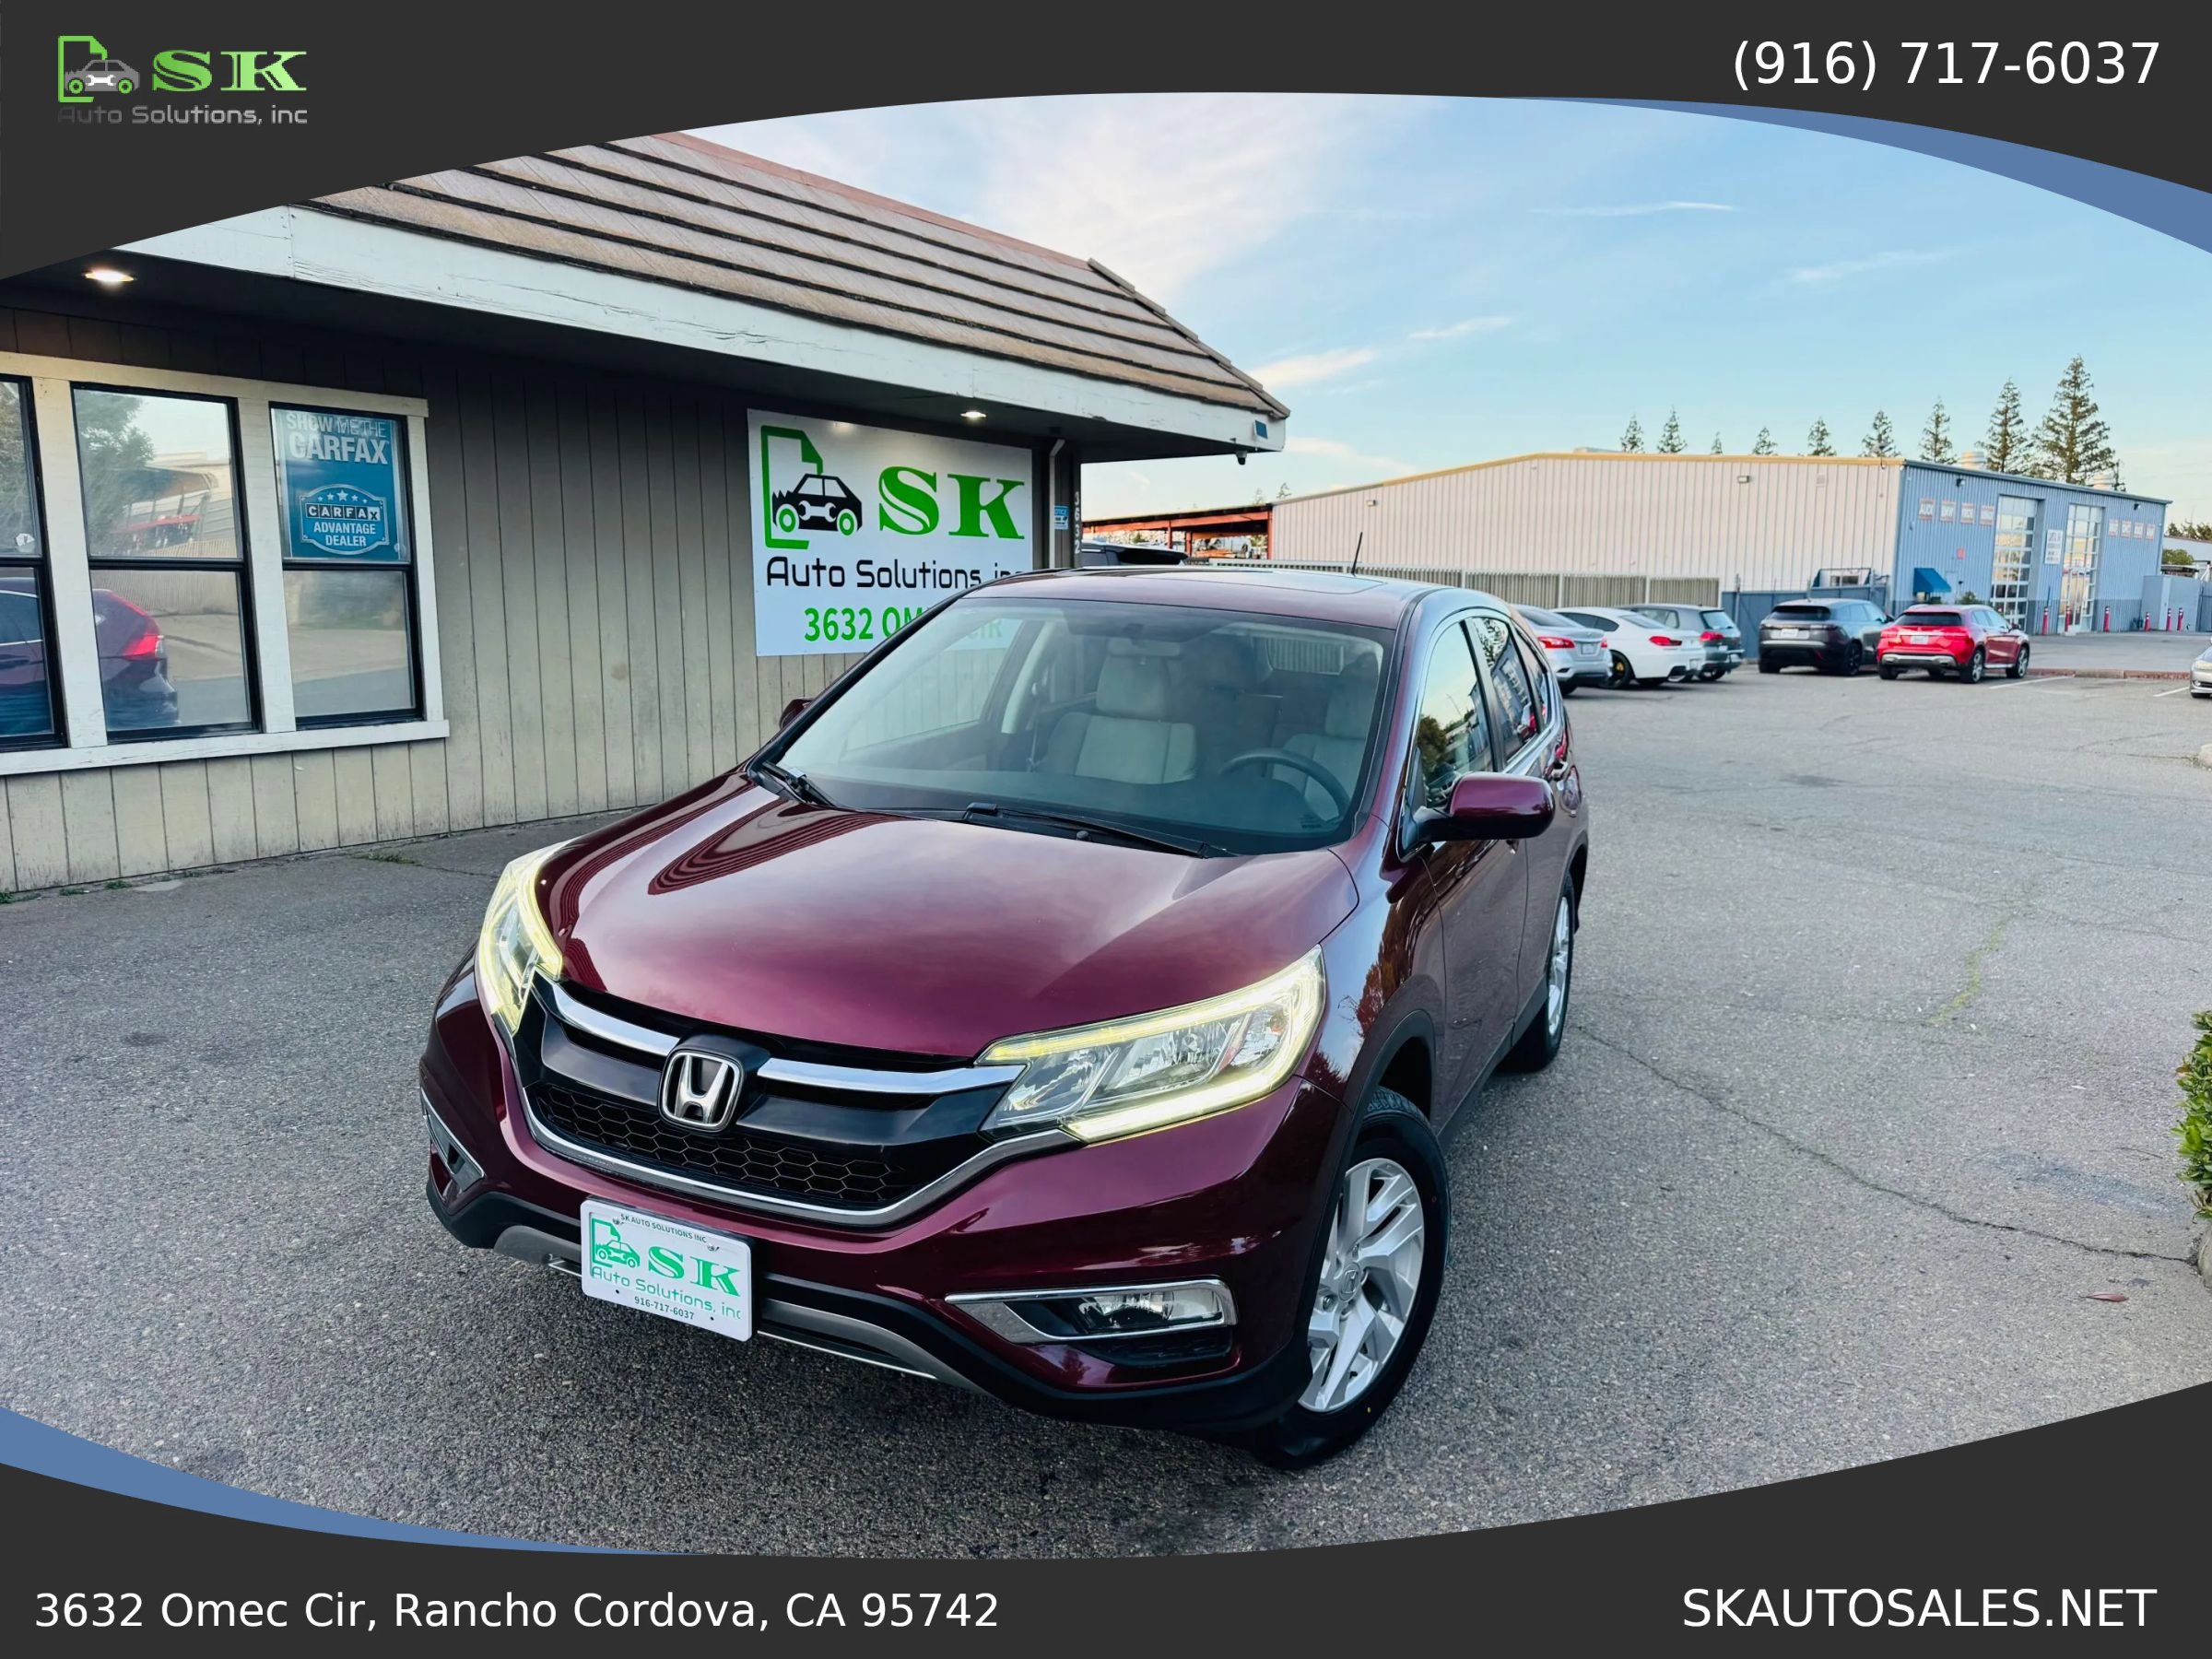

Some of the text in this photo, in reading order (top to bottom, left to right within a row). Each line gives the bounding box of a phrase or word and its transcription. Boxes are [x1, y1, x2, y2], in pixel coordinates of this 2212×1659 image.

[286, 412, 334, 433] SHOW
[288, 431, 389, 465] CARFAX
[308, 506, 381, 521] CARFAX
[878, 465, 1025, 540] SK
[313, 522, 377, 535] ADVANTAGE
[325, 535, 367, 547] DEALER
[767, 556, 845, 587] Auto
[804, 606, 874, 642] 3632
[620, 1213, 708, 1243] SK AUTO SOLUTIONS INC
[648, 1245, 740, 1297] SK
[591, 1265, 630, 1287] Auto
[635, 1278, 717, 1312] Solutions,
[634, 1296, 695, 1320] 916-717-6037
